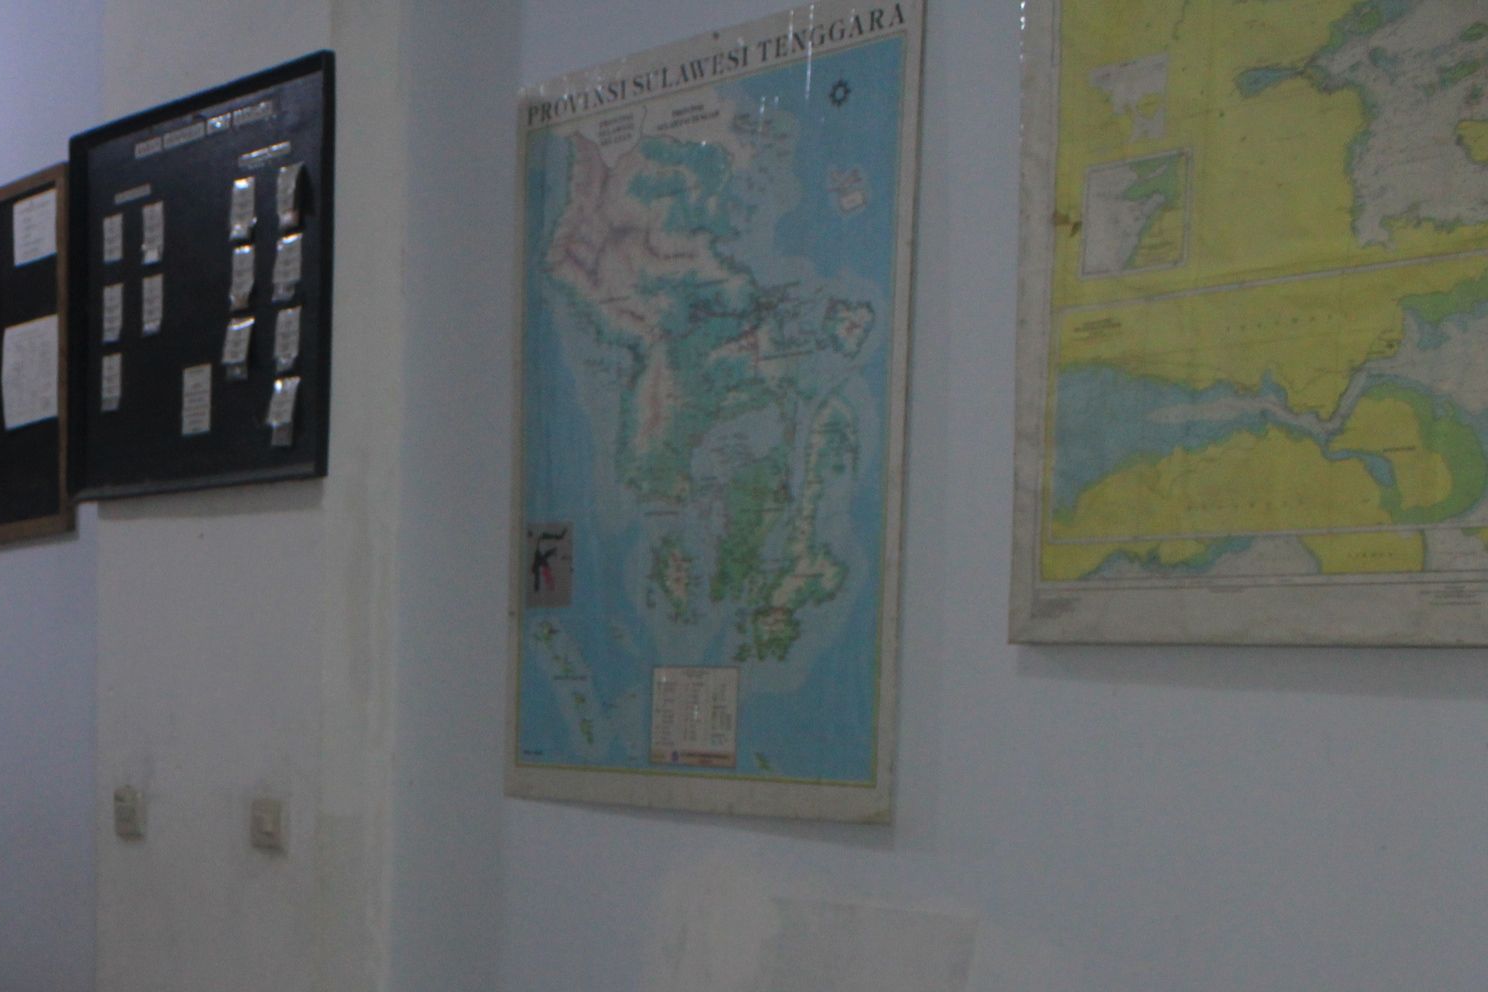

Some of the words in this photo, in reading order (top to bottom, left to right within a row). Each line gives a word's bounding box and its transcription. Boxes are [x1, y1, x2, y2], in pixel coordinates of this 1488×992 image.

[526, 78, 627, 126] PROVINSI
[631, 45, 750, 97] SULAWESI
[757, 2, 906, 63] TENGGARA
